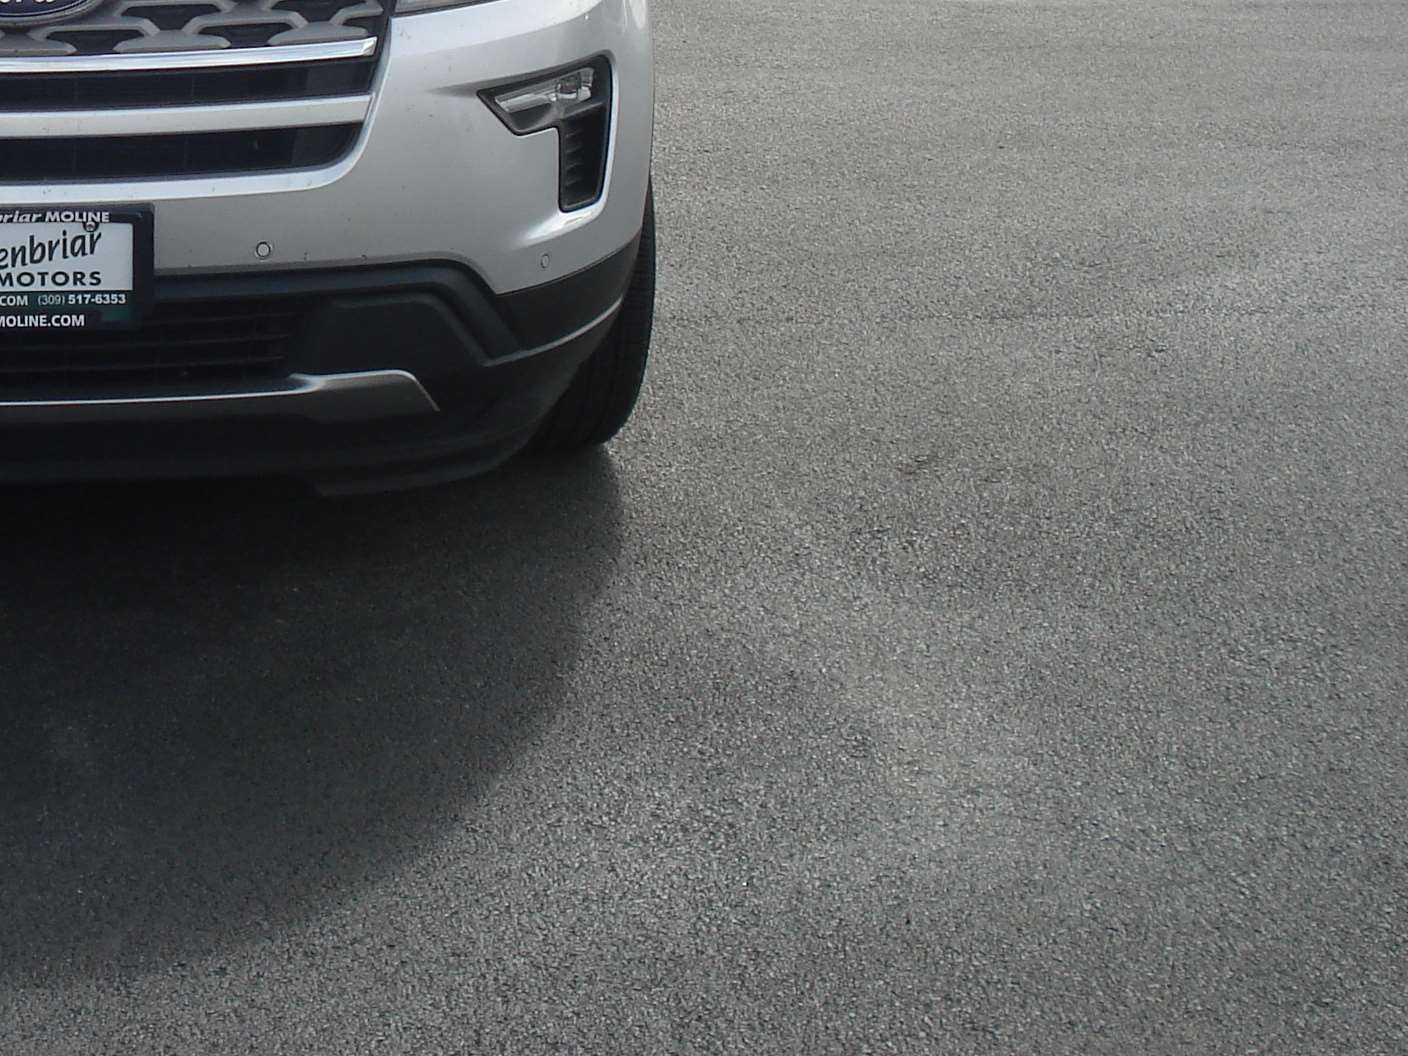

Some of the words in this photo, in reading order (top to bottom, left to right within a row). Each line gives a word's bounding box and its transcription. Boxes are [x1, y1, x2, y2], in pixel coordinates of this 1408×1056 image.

[45, 211, 110, 223] MOLINE
[37, 294, 66, 306] (309)
[67, 293, 127, 305] 517-6353
